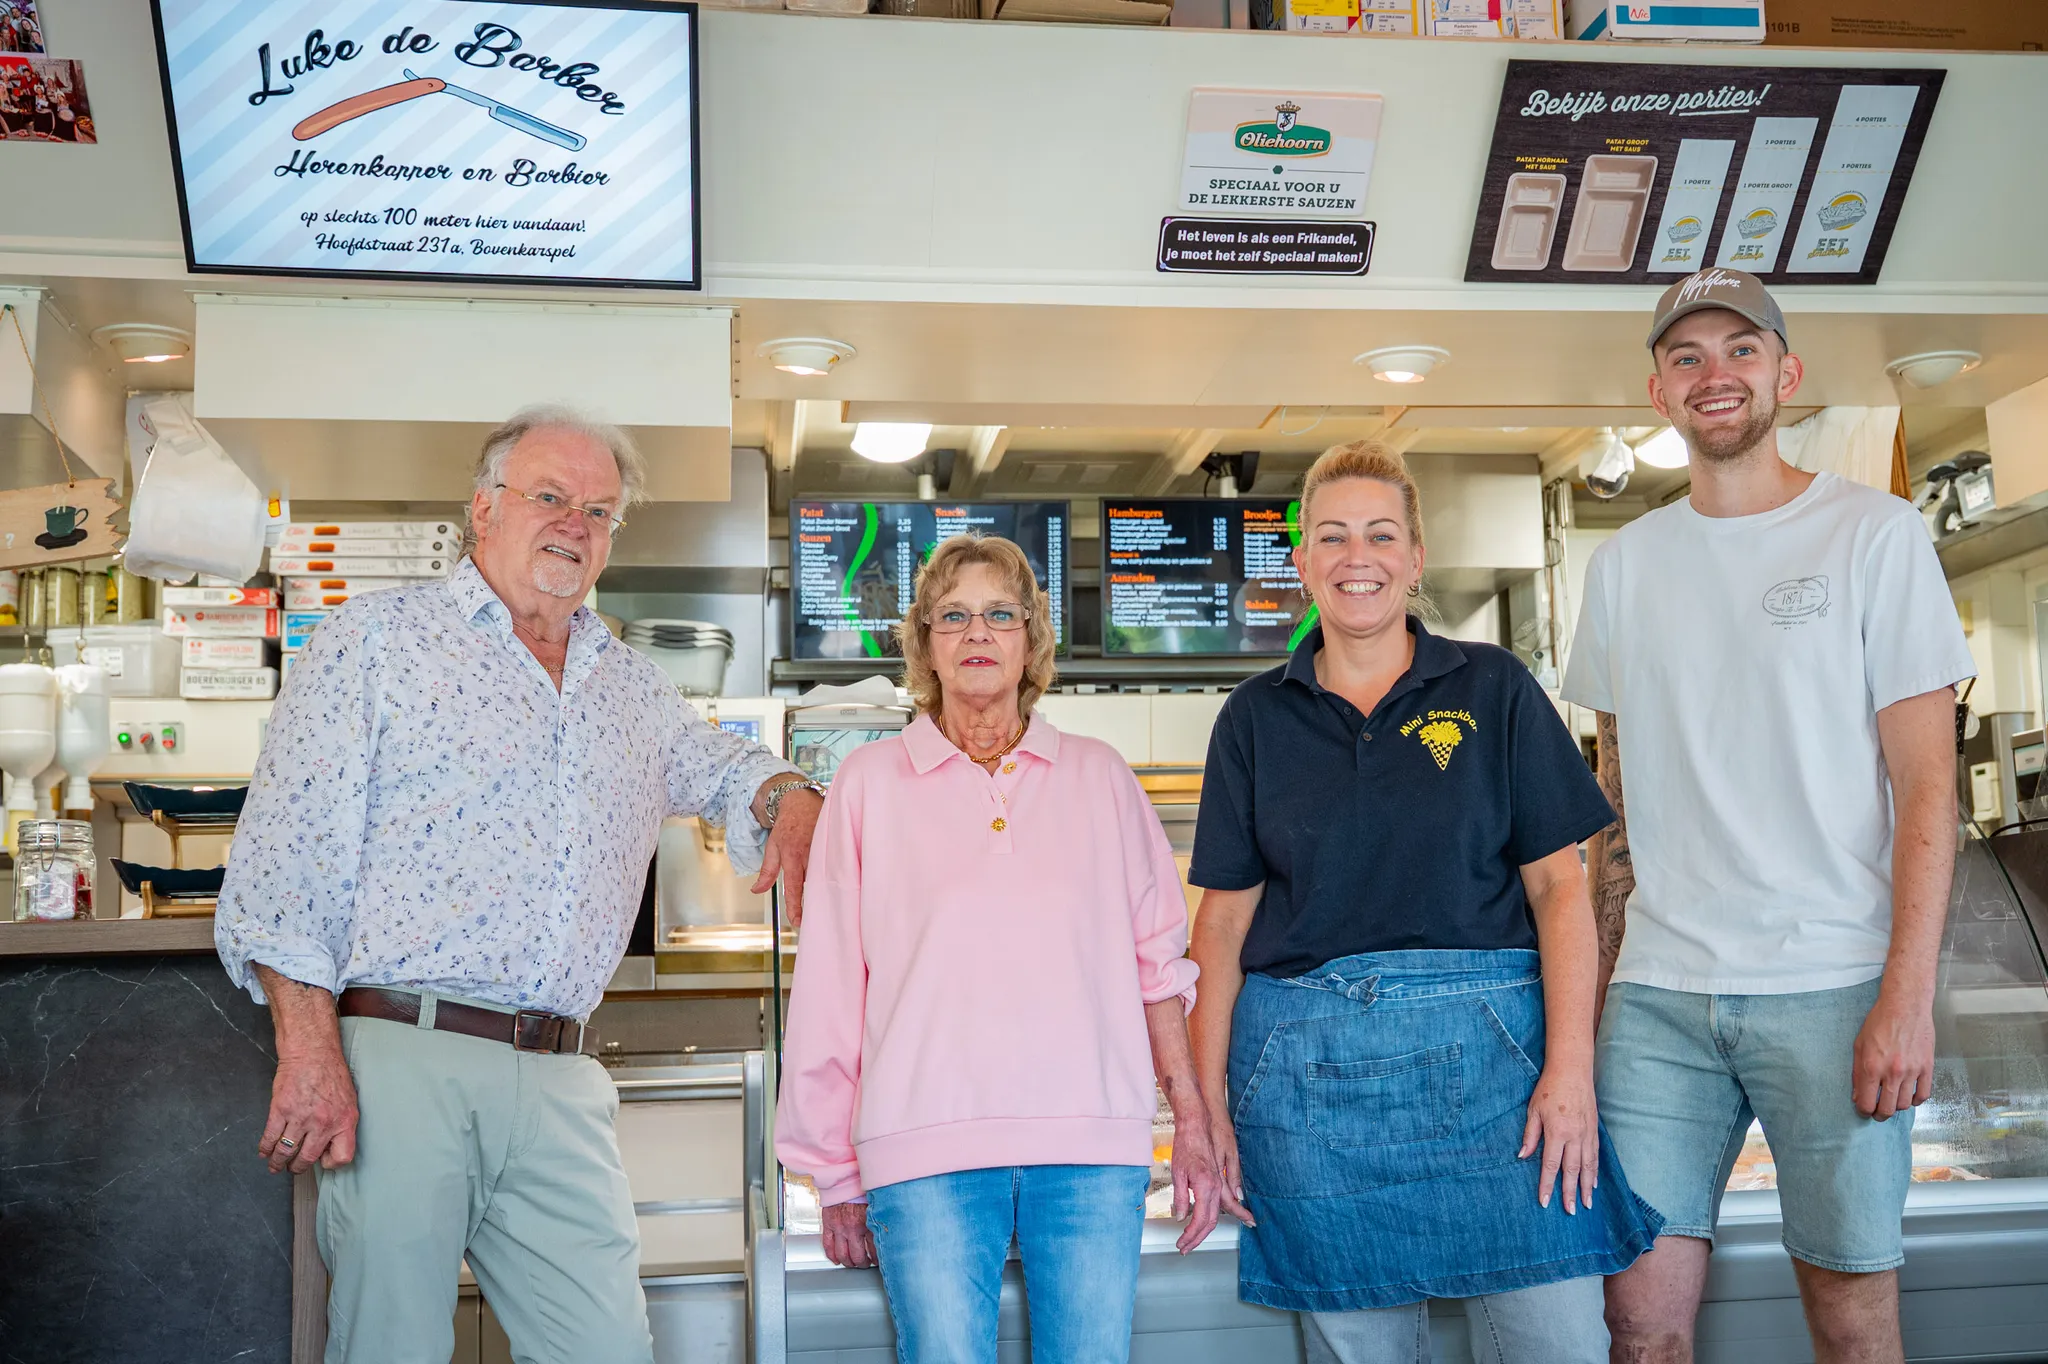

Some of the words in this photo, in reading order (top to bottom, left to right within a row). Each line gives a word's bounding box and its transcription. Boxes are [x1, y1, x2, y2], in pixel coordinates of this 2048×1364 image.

[248, 29, 363, 106] Luke
[382, 26, 439, 54] de
[454, 22, 624, 115] Barber
[1520, 89, 1607, 121] Bekijk
[1611, 94, 1671, 113] onze
[1669, 84, 1772, 115] porties!
[1240, 131, 1325, 151] Oliehoorn
[1626, 138, 1650, 146] GROOT
[1536, 156, 1568, 164] NORMAAL
[274, 149, 453, 183] Herenkapper
[463, 163, 498, 181] en
[504, 158, 611, 187] Barbier
[1209, 179, 1280, 192] SPECIAAL
[1284, 181, 1325, 193] VOOR
[1329, 183, 1341, 193] U
[1188, 193, 1208, 204] DE
[1212, 194, 1295, 207] LEKKERSTE
[1298, 197, 1356, 209] SAUZEN
[300, 210, 318, 231] op
[324, 209, 380, 226] slechts
[383, 208, 417, 226] 100
[424, 213, 472, 229] meter
[475, 215, 508, 230] hier
[513, 218, 587, 233] vandaan!
[1178, 230, 1200, 242] Het
[1203, 231, 1236, 244] leven
[1251, 232, 1270, 244] als
[1272, 234, 1294, 244] een
[1297, 232, 1358, 246] Frikandel,
[1816, 238, 1849, 252] EET
[315, 233, 414, 256] Hoofdstraat
[470, 239, 576, 263] Bovenkarspel
[1166, 248, 1178, 261] je
[1181, 249, 1213, 261] moet
[1215, 249, 1236, 261] het
[1238, 250, 1260, 262] zelf
[1263, 251, 1315, 264] Speciaal
[1318, 252, 1363, 264] maken!
[800, 508, 824, 517] Patat
[1109, 508, 1163, 520] Hamburgers
[1243, 509, 1282, 521] Broodjes
[800, 533, 831, 543] Sauzen
[1110, 573, 1155, 583] Aanraders
[1245, 599, 1278, 610] Salades
[1399, 714, 1424, 737] Mini
[1427, 709, 1478, 733] Snackbar
